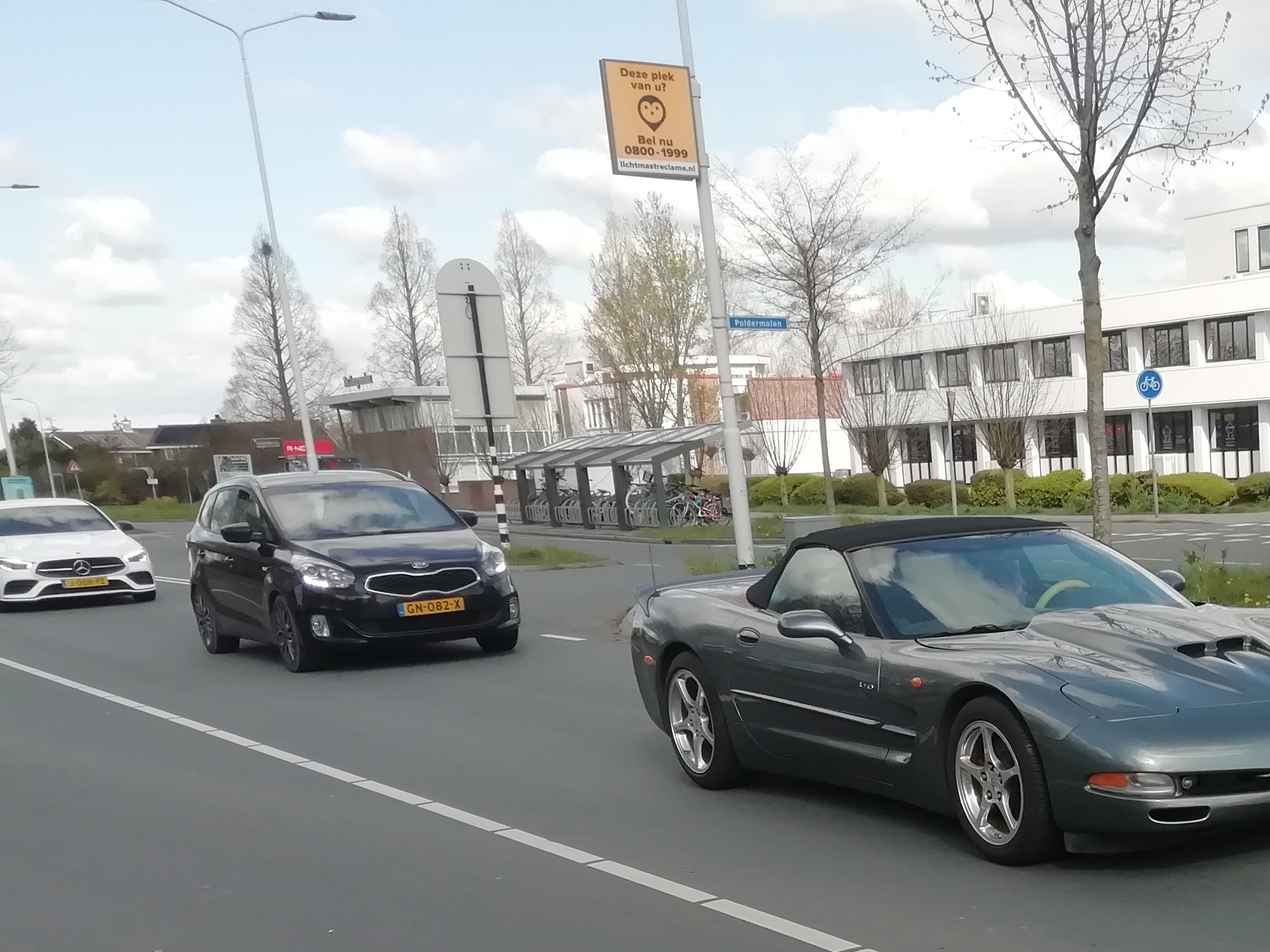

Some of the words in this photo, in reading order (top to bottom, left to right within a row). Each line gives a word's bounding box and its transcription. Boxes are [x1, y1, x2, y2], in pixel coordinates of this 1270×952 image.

[620, 68, 648, 79] Deze
[651, 72, 675, 82] plek
[631, 82, 651, 91] van
[655, 83, 666, 92] u?
[637, 135, 656, 145] Bel
[659, 138, 673, 146] nu
[624, 145, 688, 158] 0800-1999
[620, 160, 696, 172] lichtmastreclame.nl
[734, 319, 782, 327] Poldermolen
[407, 599, 461, 614] GN-082-X
